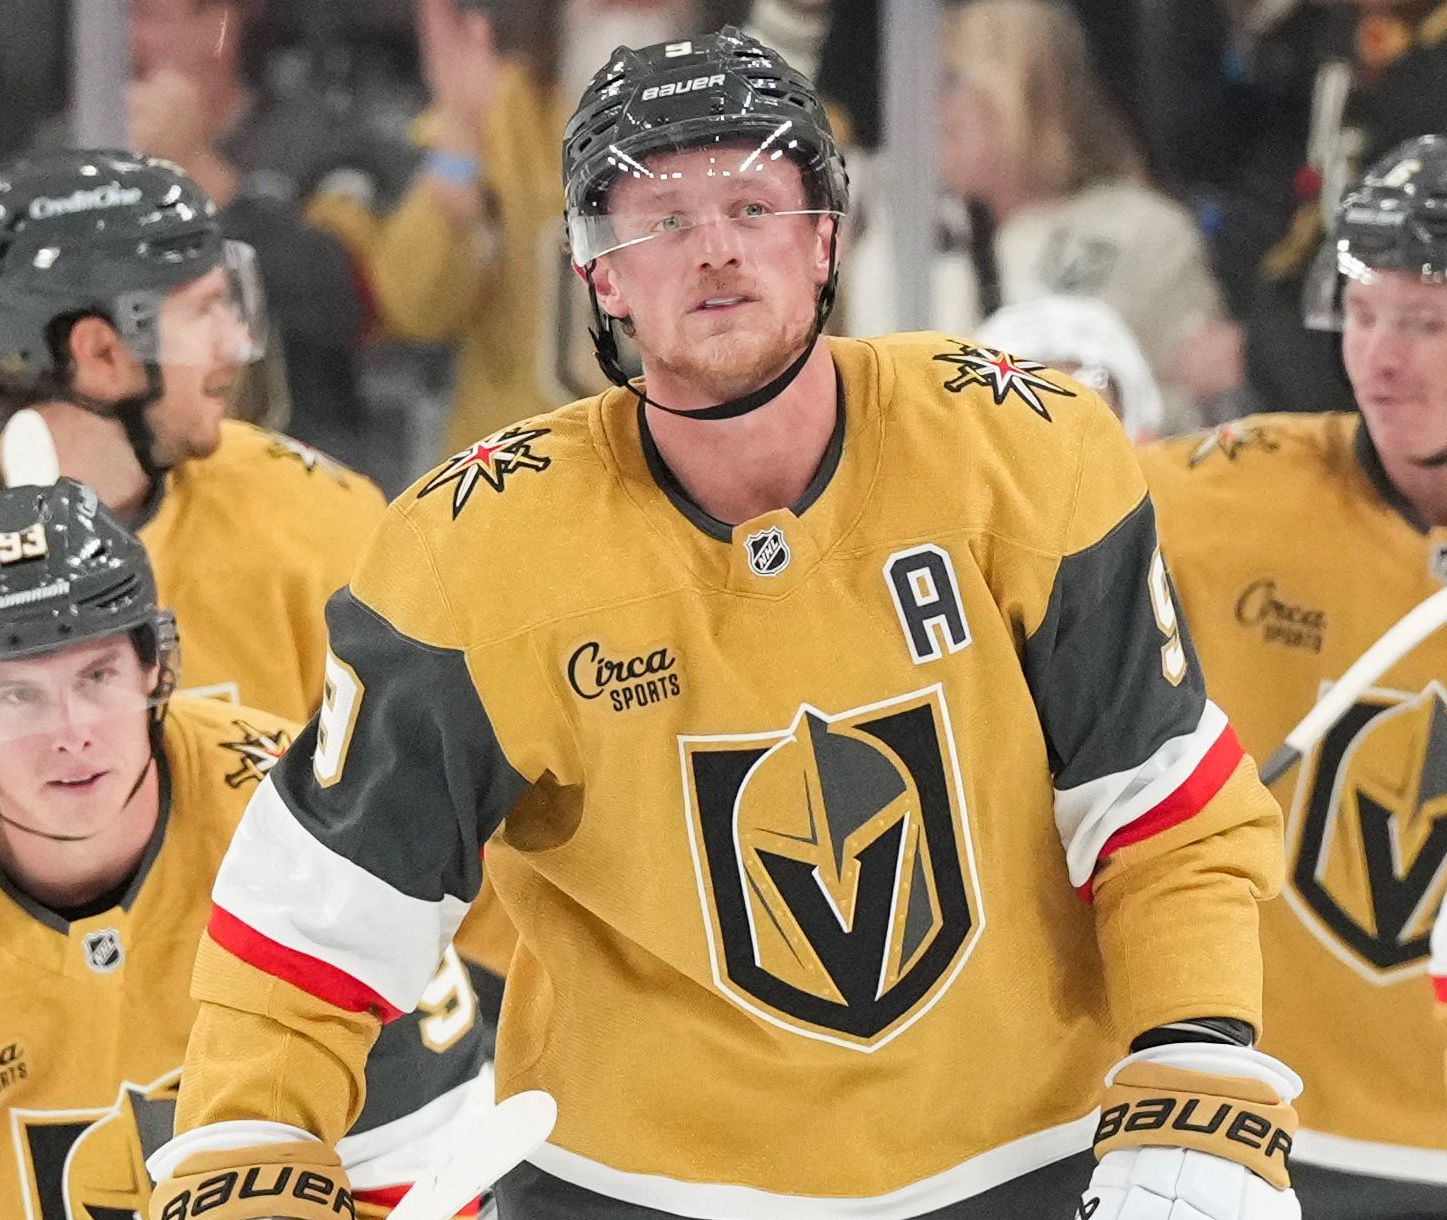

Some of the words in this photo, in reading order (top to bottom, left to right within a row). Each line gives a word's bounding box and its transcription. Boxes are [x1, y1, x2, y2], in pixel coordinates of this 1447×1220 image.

[641, 73, 726, 101] BAUER
[882, 543, 972, 666] A
[567, 641, 676, 699] Circa
[609, 673, 680, 712] SPORTS
